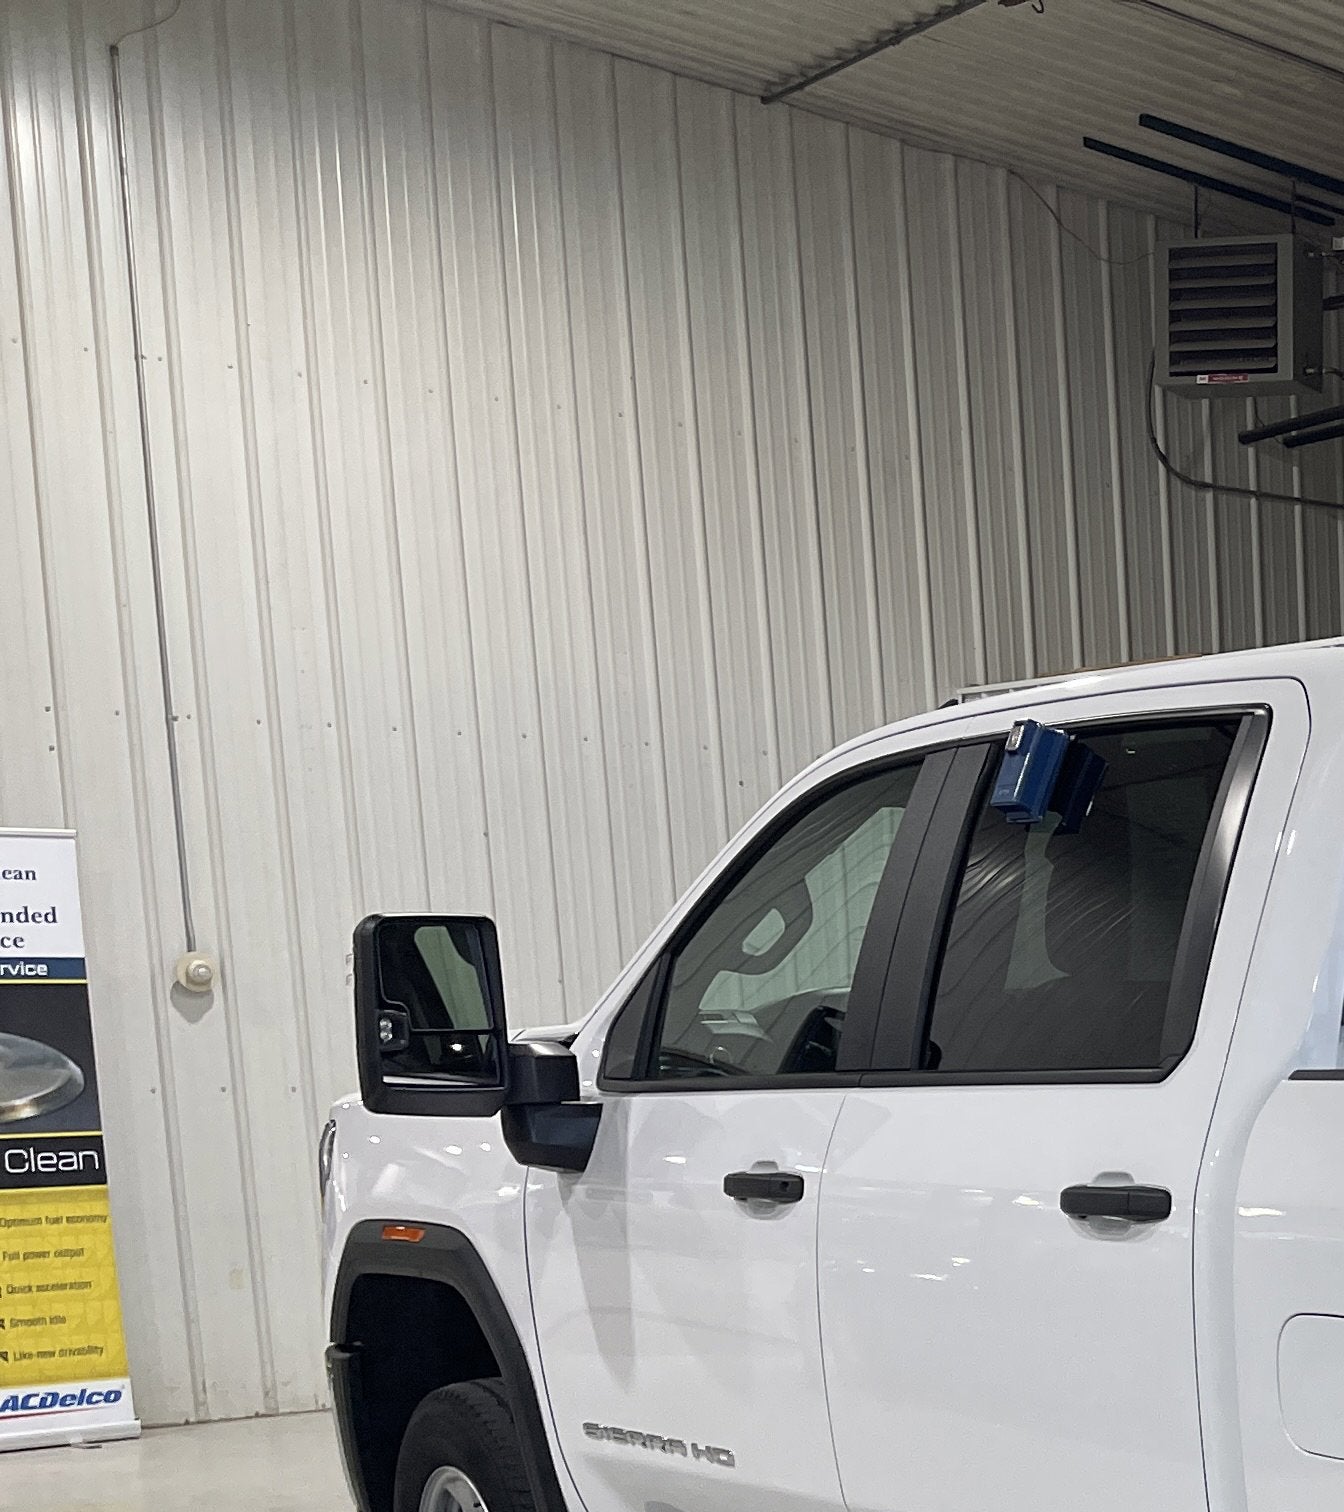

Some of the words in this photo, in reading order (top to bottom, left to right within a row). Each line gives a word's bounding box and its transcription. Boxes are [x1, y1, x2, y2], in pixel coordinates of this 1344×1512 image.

[4, 1148, 99, 1174] Clean
[0, 1388, 122, 1413] ACDelco
[582, 1421, 688, 1458] SIERRA
[690, 1442, 736, 1468] HD
